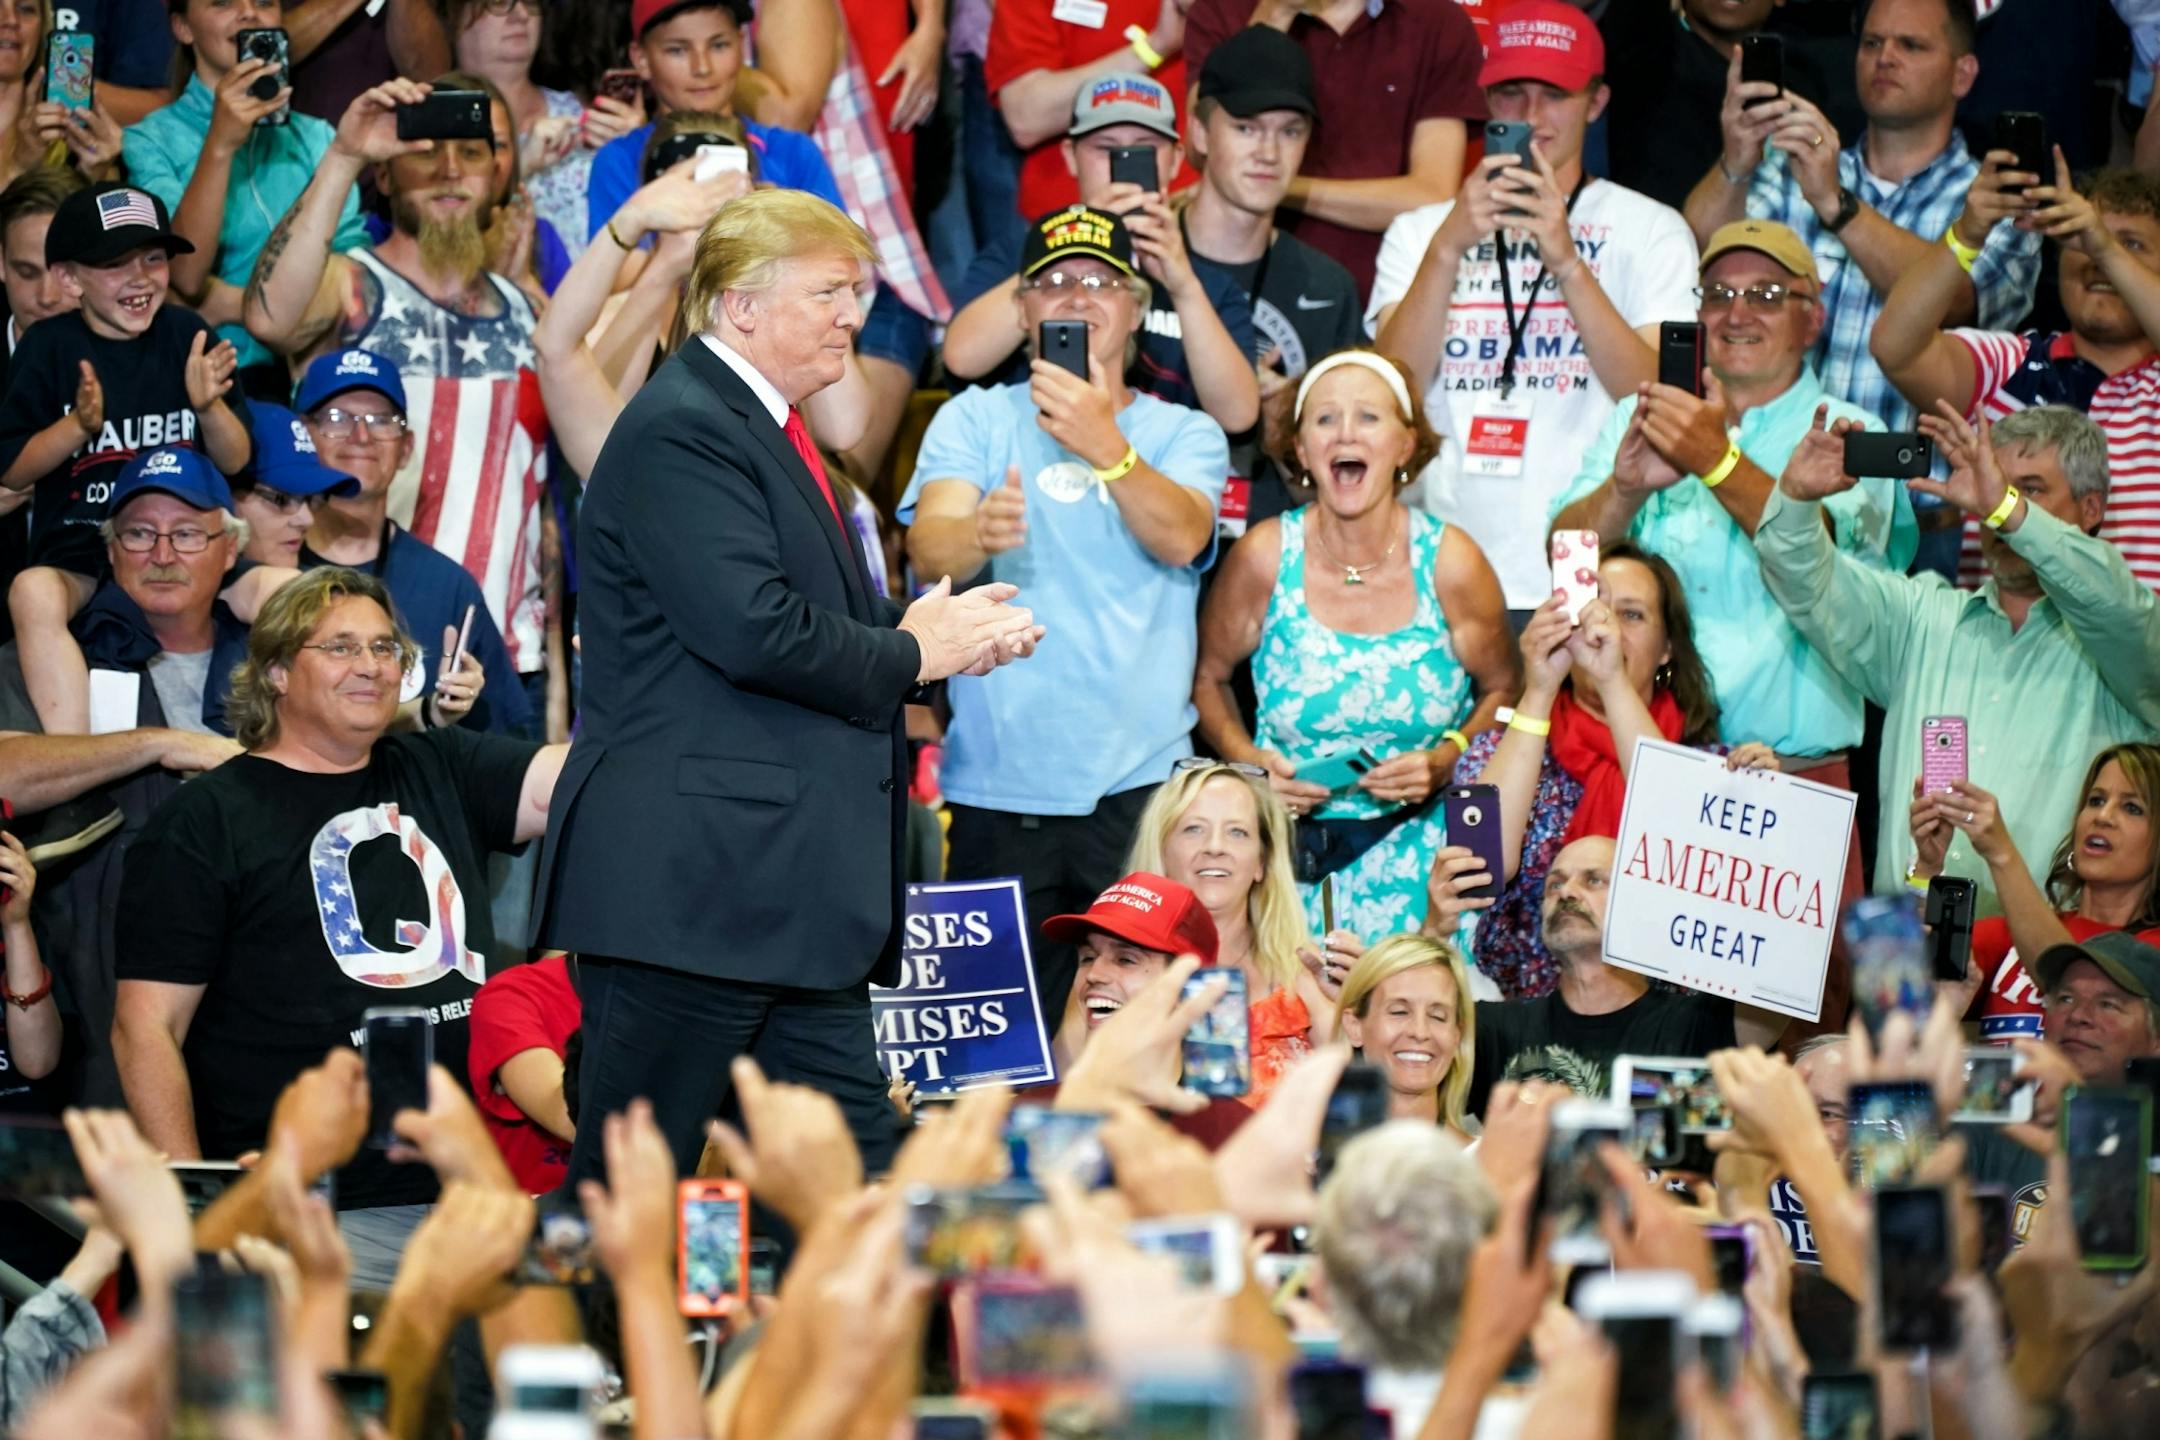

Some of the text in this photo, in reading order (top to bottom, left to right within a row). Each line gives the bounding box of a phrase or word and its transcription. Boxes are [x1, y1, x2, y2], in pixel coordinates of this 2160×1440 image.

[1528, 20, 1577, 41] AMERICA
[1501, 35, 1571, 51] GREAT AGAIN
[1446, 362, 1477, 376] PUT
[1538, 361, 1556, 374] IN
[1699, 792, 1778, 839] KEEP
[1624, 831, 1825, 929] AMERICA
[309, 802, 486, 989] Q
[1120, 883, 1163, 906] AMERICA
[1120, 895, 1152, 913] AGAIN
[1669, 914, 1766, 967] GREAT
